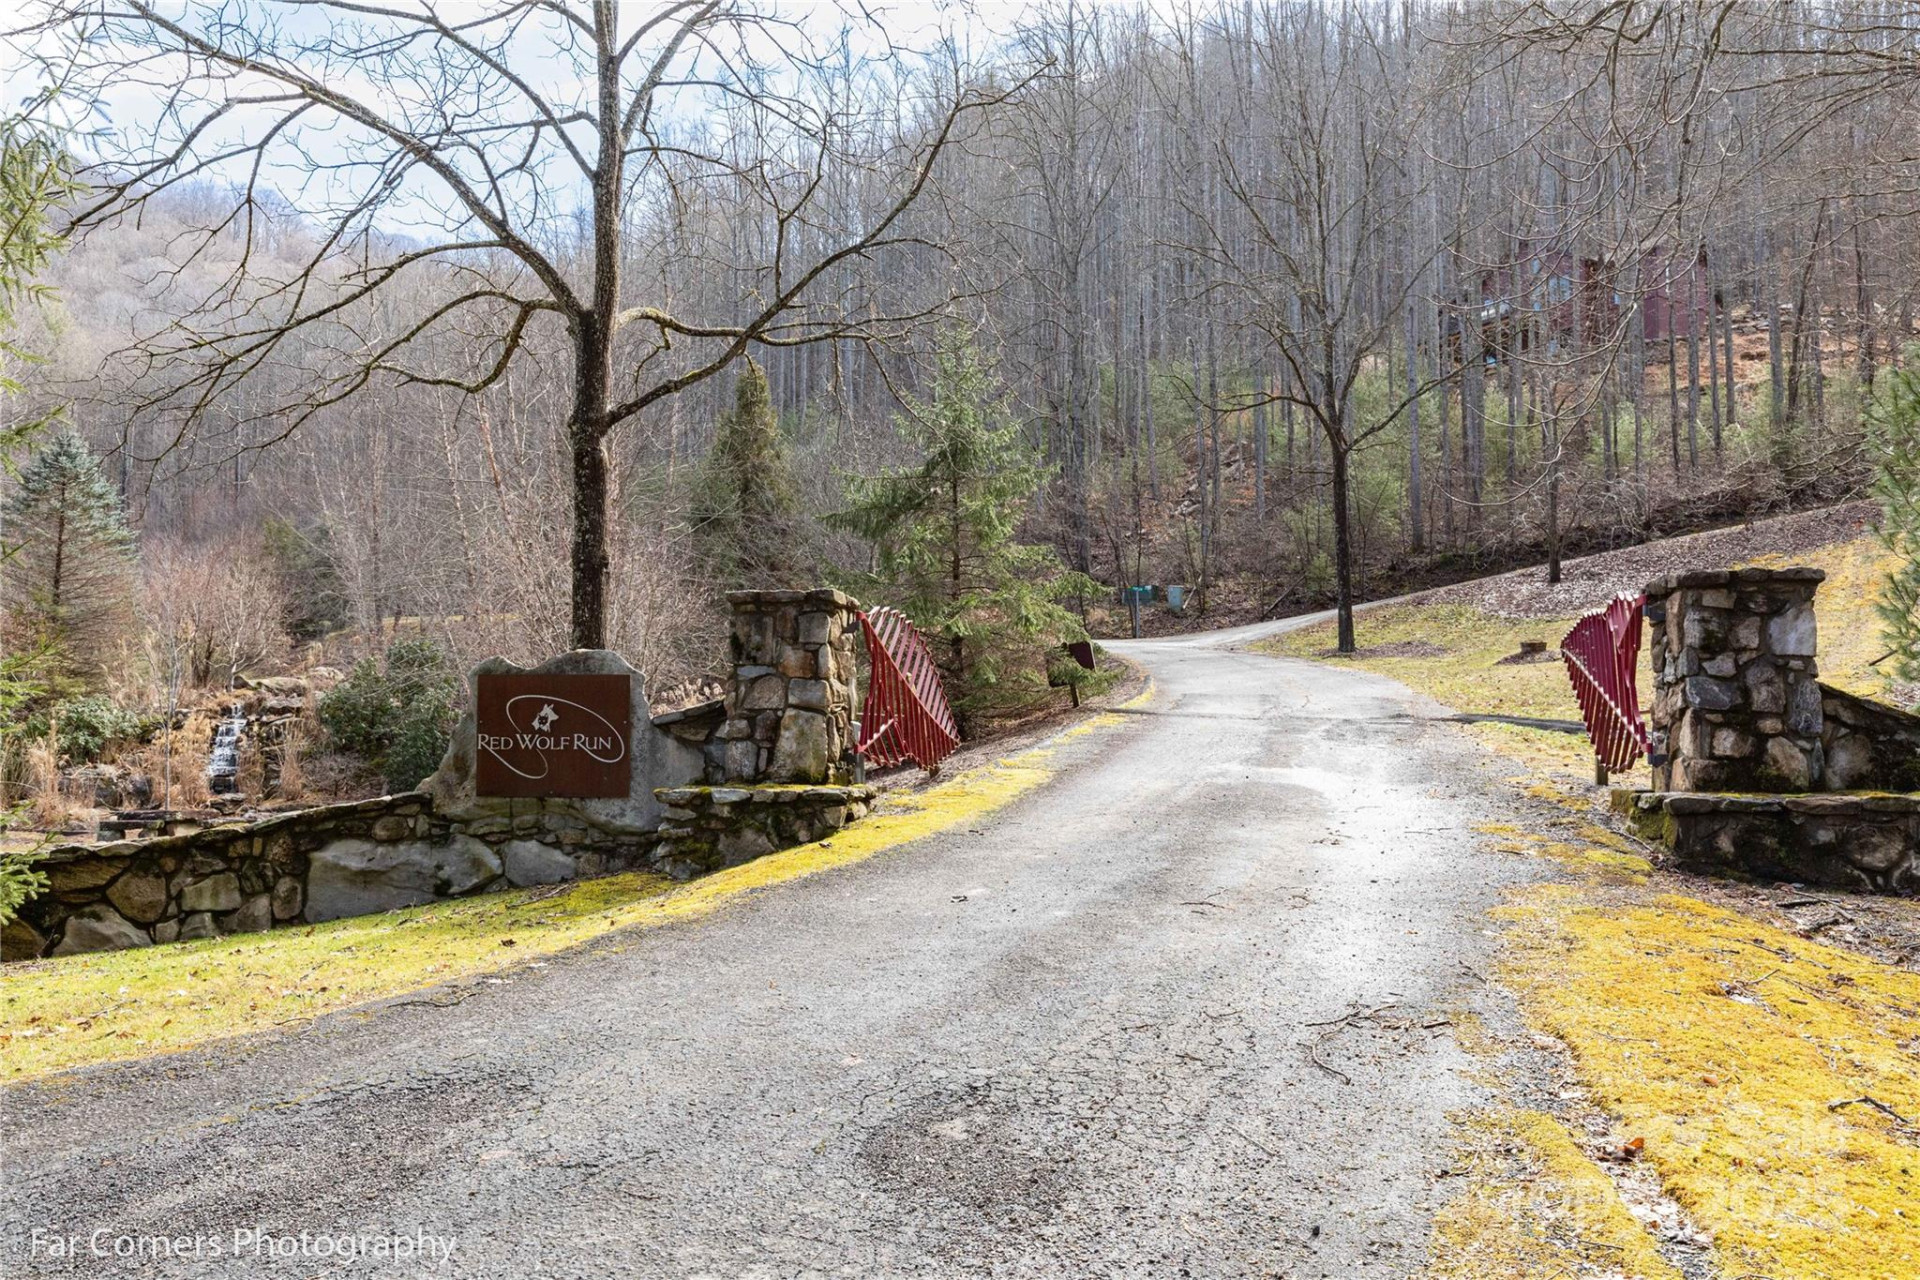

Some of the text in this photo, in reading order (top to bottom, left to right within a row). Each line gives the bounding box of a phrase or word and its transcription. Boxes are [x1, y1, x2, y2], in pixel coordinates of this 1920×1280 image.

[478, 733, 612, 750] RED WOLF RUN
